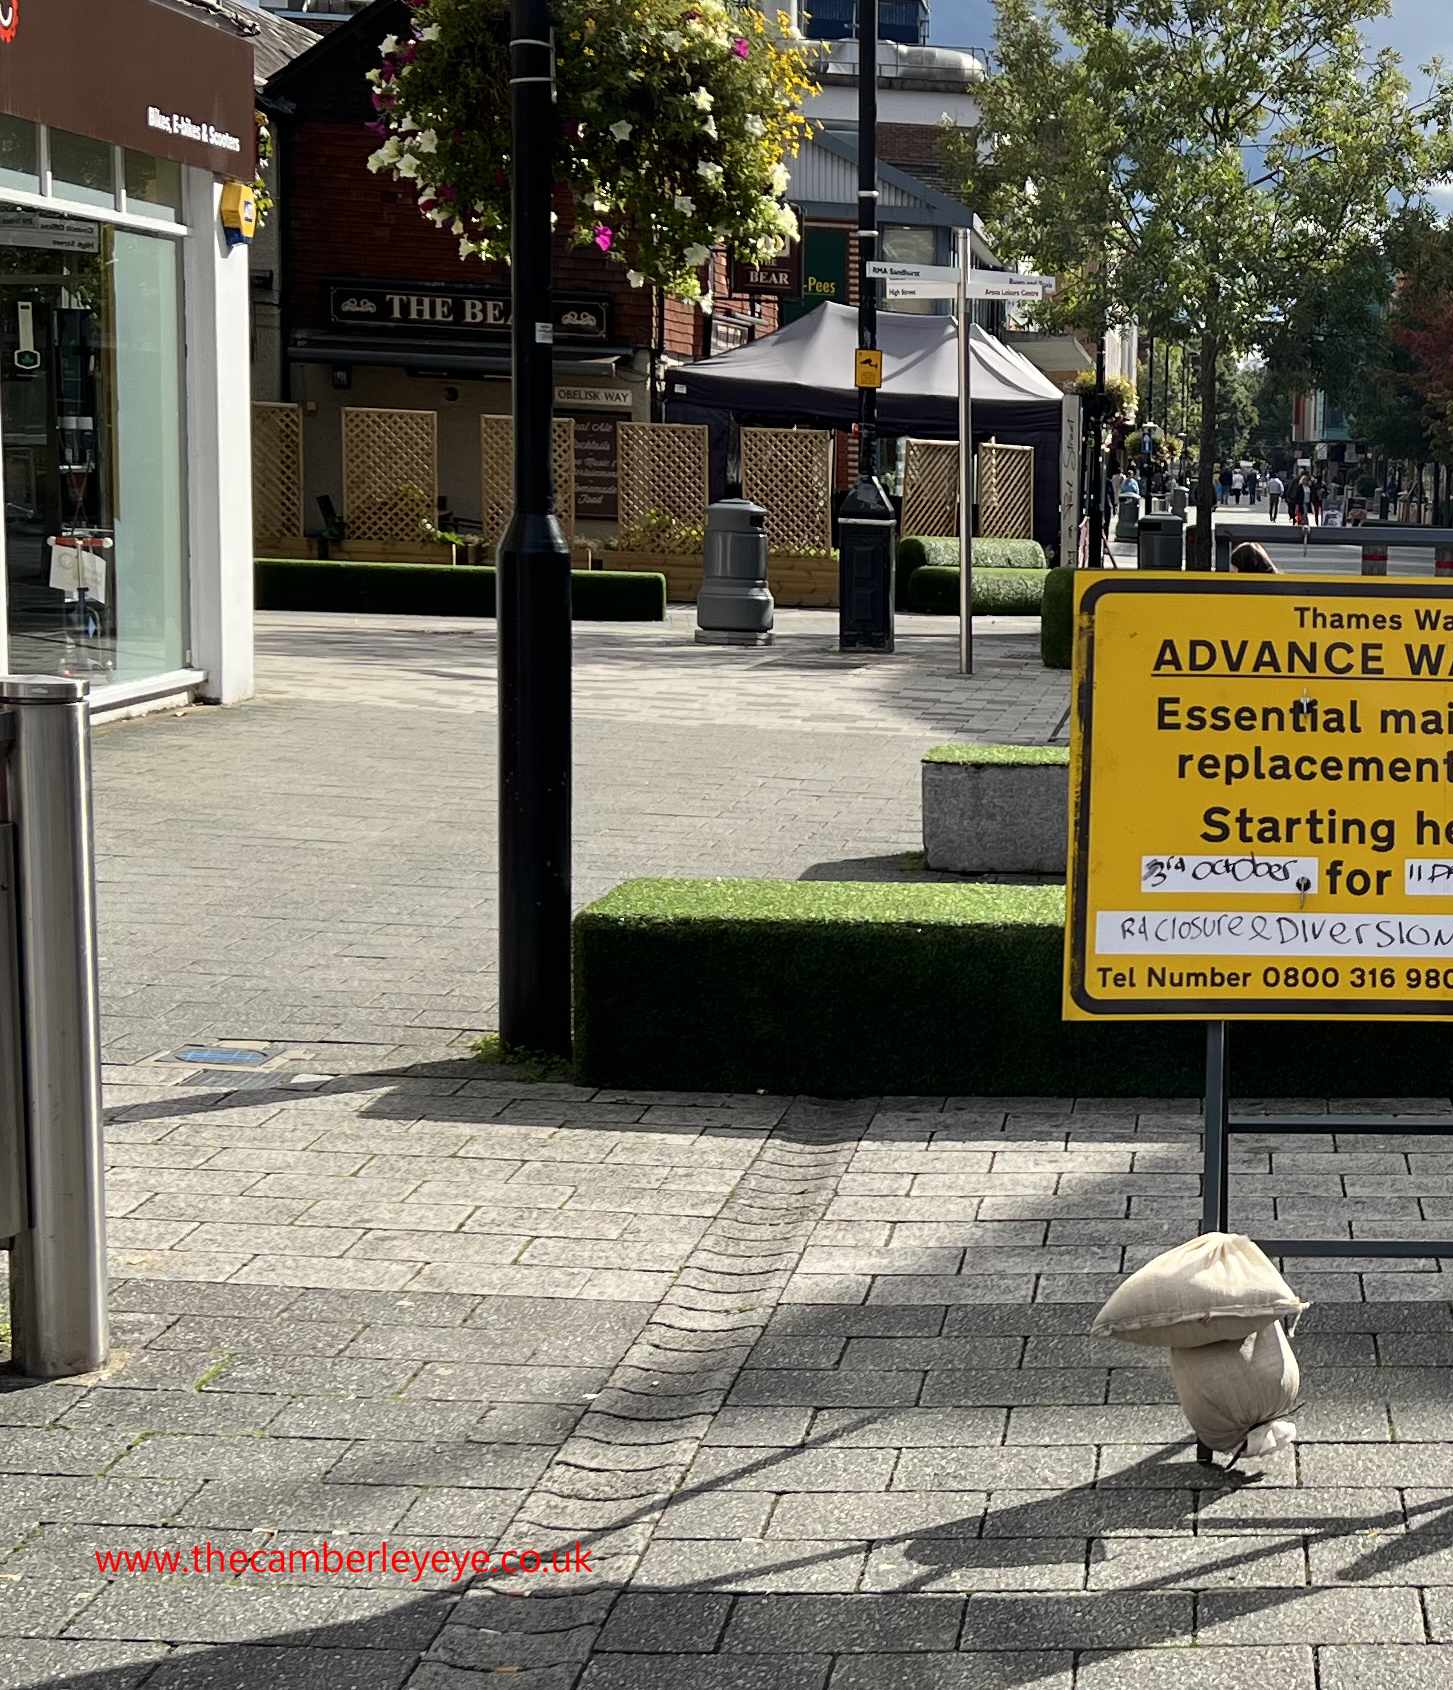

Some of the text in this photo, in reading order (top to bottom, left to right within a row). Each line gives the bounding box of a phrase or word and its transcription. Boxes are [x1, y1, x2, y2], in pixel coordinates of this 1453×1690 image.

[749, 270, 790, 285] BEAR
[889, 288, 916, 297] High Street
[386, 294, 453, 321] THE
[558, 389, 629, 403] OBELISK WAY
[1294, 606, 1402, 631] Thames
[1153, 638, 1385, 675] ADVANCE
[1157, 696, 1362, 734] Essential
[1200, 805, 1395, 853] Starting
[1325, 859, 1393, 896] for
[1096, 966, 1137, 988] Tel
[1147, 965, 1253, 989] Number
[1261, 966, 1340, 989] 0800
[1349, 966, 1396, 989] 316
